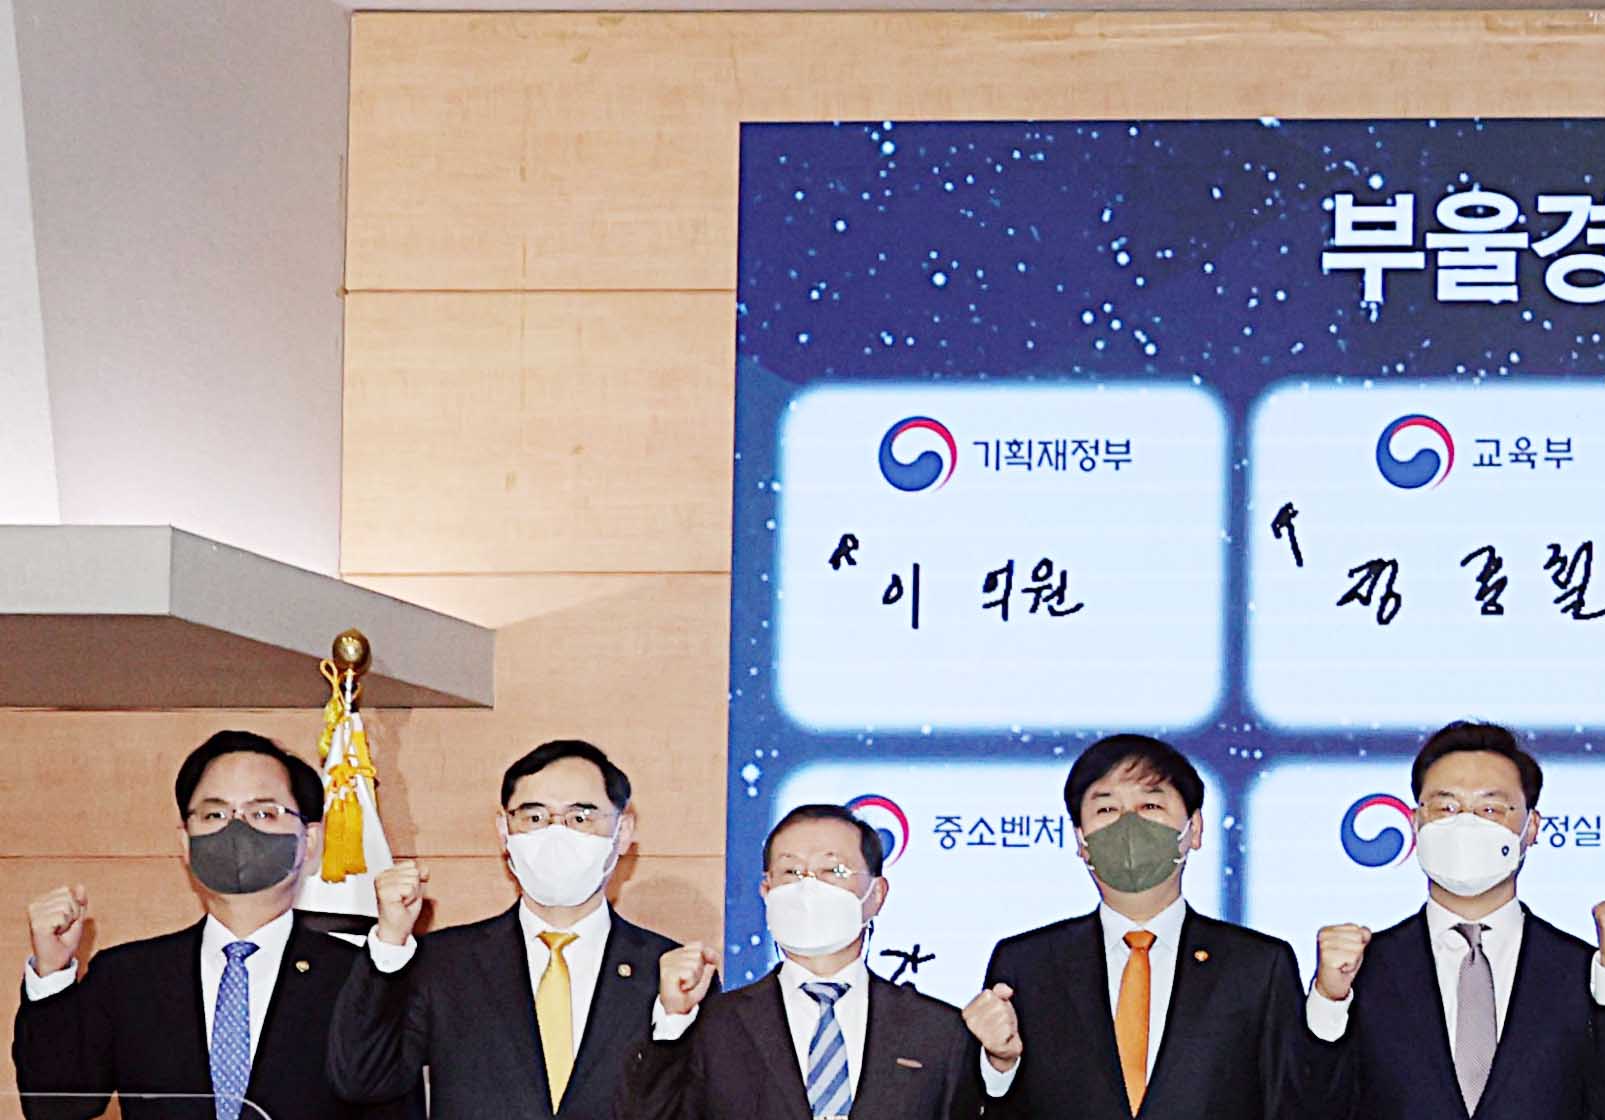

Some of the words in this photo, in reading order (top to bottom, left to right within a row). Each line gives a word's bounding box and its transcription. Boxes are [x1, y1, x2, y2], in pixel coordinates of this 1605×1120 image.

[972, 438, 1133, 474] 기획재정부
[1472, 436, 1575, 470] 교육부
[933, 815, 1064, 851] 중소벤처
